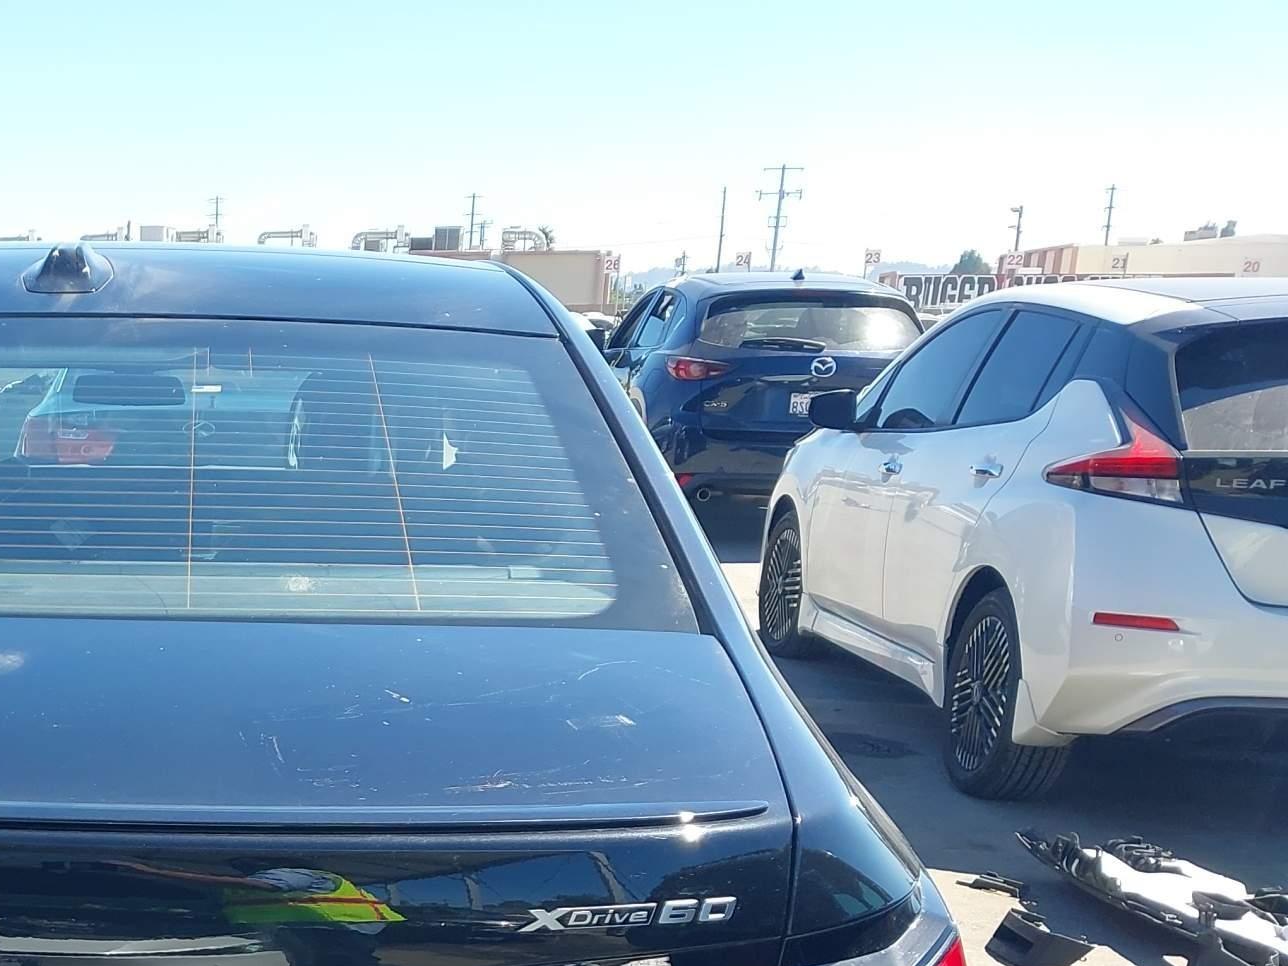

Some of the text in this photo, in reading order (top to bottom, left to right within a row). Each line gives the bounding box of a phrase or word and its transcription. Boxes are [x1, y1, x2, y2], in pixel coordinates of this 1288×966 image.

[736, 254, 751, 266] 24
[865, 252, 880, 264] 23
[1007, 254, 1023, 266] 22
[1111, 257, 1127, 269] 21
[605, 259, 620, 270] 26
[1242, 260, 1261, 273] 20
[1215, 477, 1287, 489] LEAF
